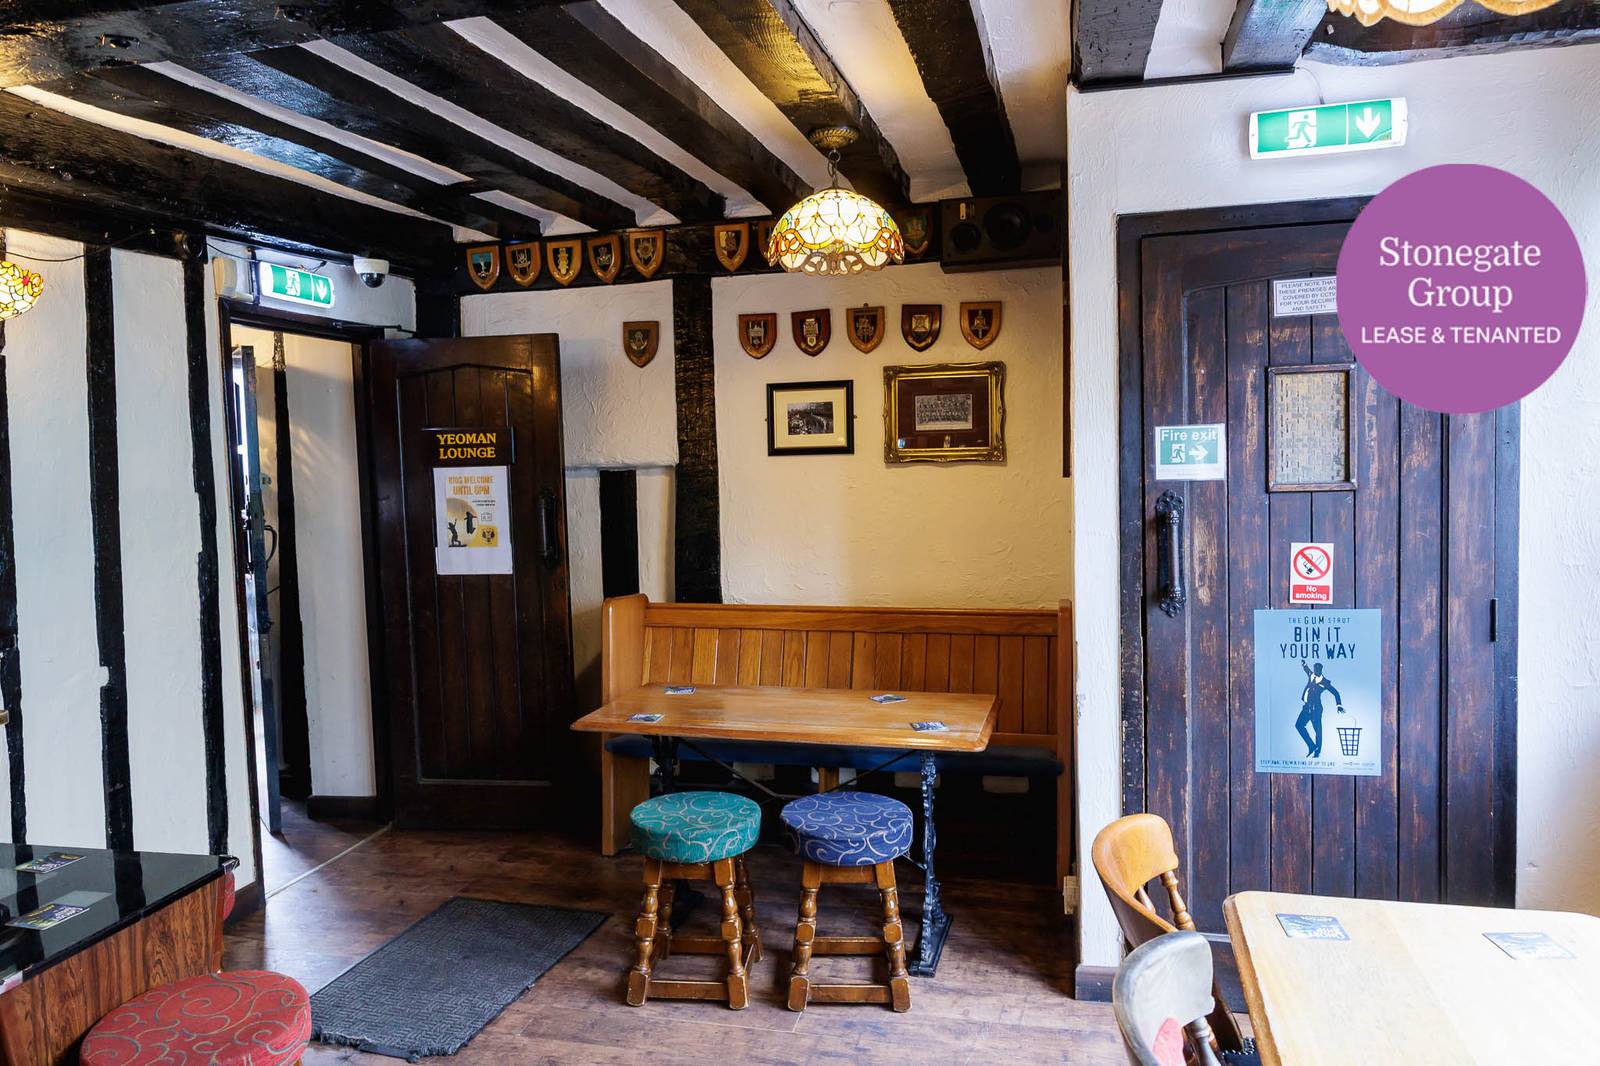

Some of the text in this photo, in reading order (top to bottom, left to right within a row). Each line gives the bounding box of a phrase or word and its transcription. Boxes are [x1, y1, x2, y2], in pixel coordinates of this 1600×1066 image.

[437, 432, 497, 445] YEOMAN
[1161, 428, 1217, 441] Fire exit
[439, 447, 496, 459] LOUNGE
[453, 485, 473, 495] UNTIL
[1295, 592, 1327, 600] smoking
[1304, 616, 1325, 625] GUM
[1294, 626, 1341, 643] BIN IT
[1280, 643, 1356, 660] YOUR WAY
